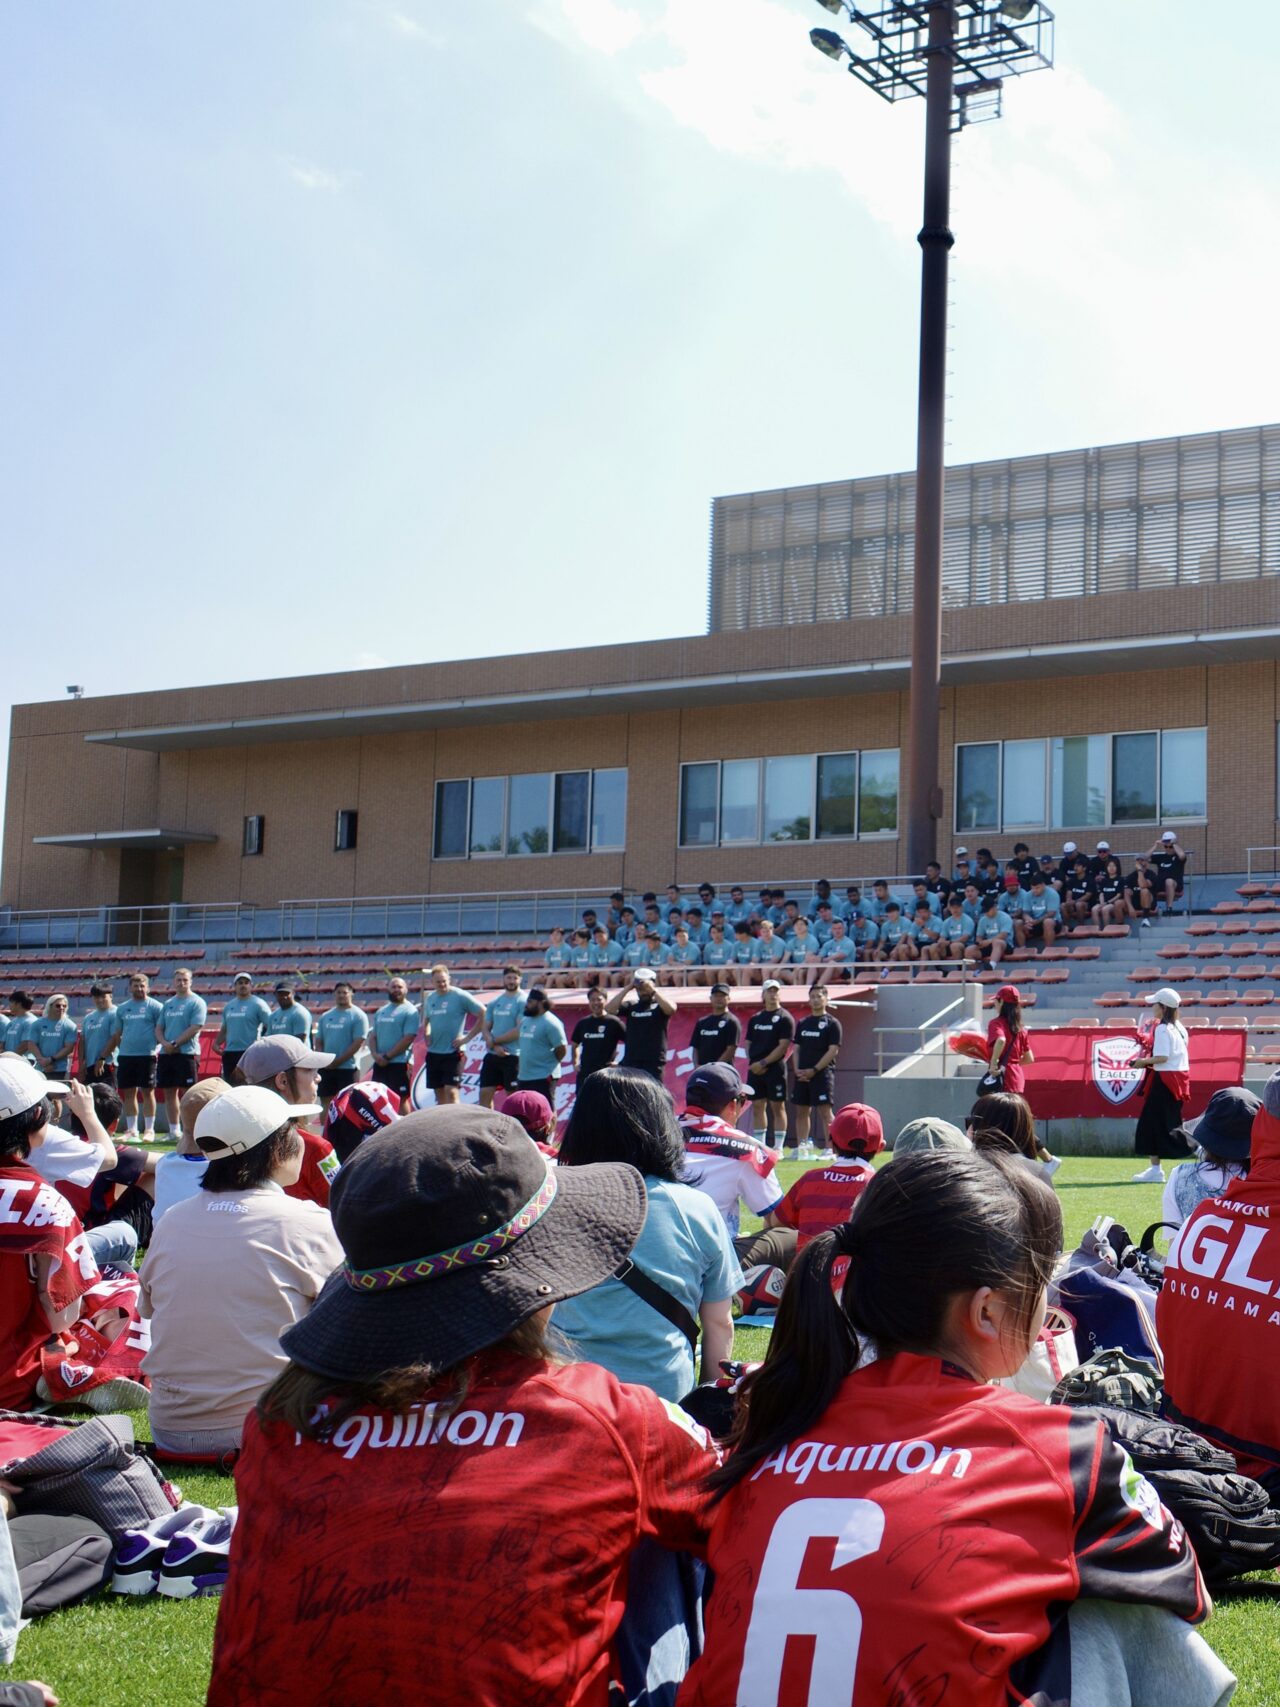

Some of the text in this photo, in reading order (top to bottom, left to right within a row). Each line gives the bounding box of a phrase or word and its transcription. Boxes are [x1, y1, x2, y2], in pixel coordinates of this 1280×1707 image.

[1100, 1070, 1138, 1079] EAGLES
[358, 1107, 380, 1128] KIPPEI
[689, 1135, 756, 1152] BRENDAN OWEN
[823, 1171, 865, 1183] YUZUKI
[1161, 1278, 1280, 1326] YOKOHAMA
[750, 1440, 972, 1484] Aquilion
[736, 1498, 886, 1707] 6
